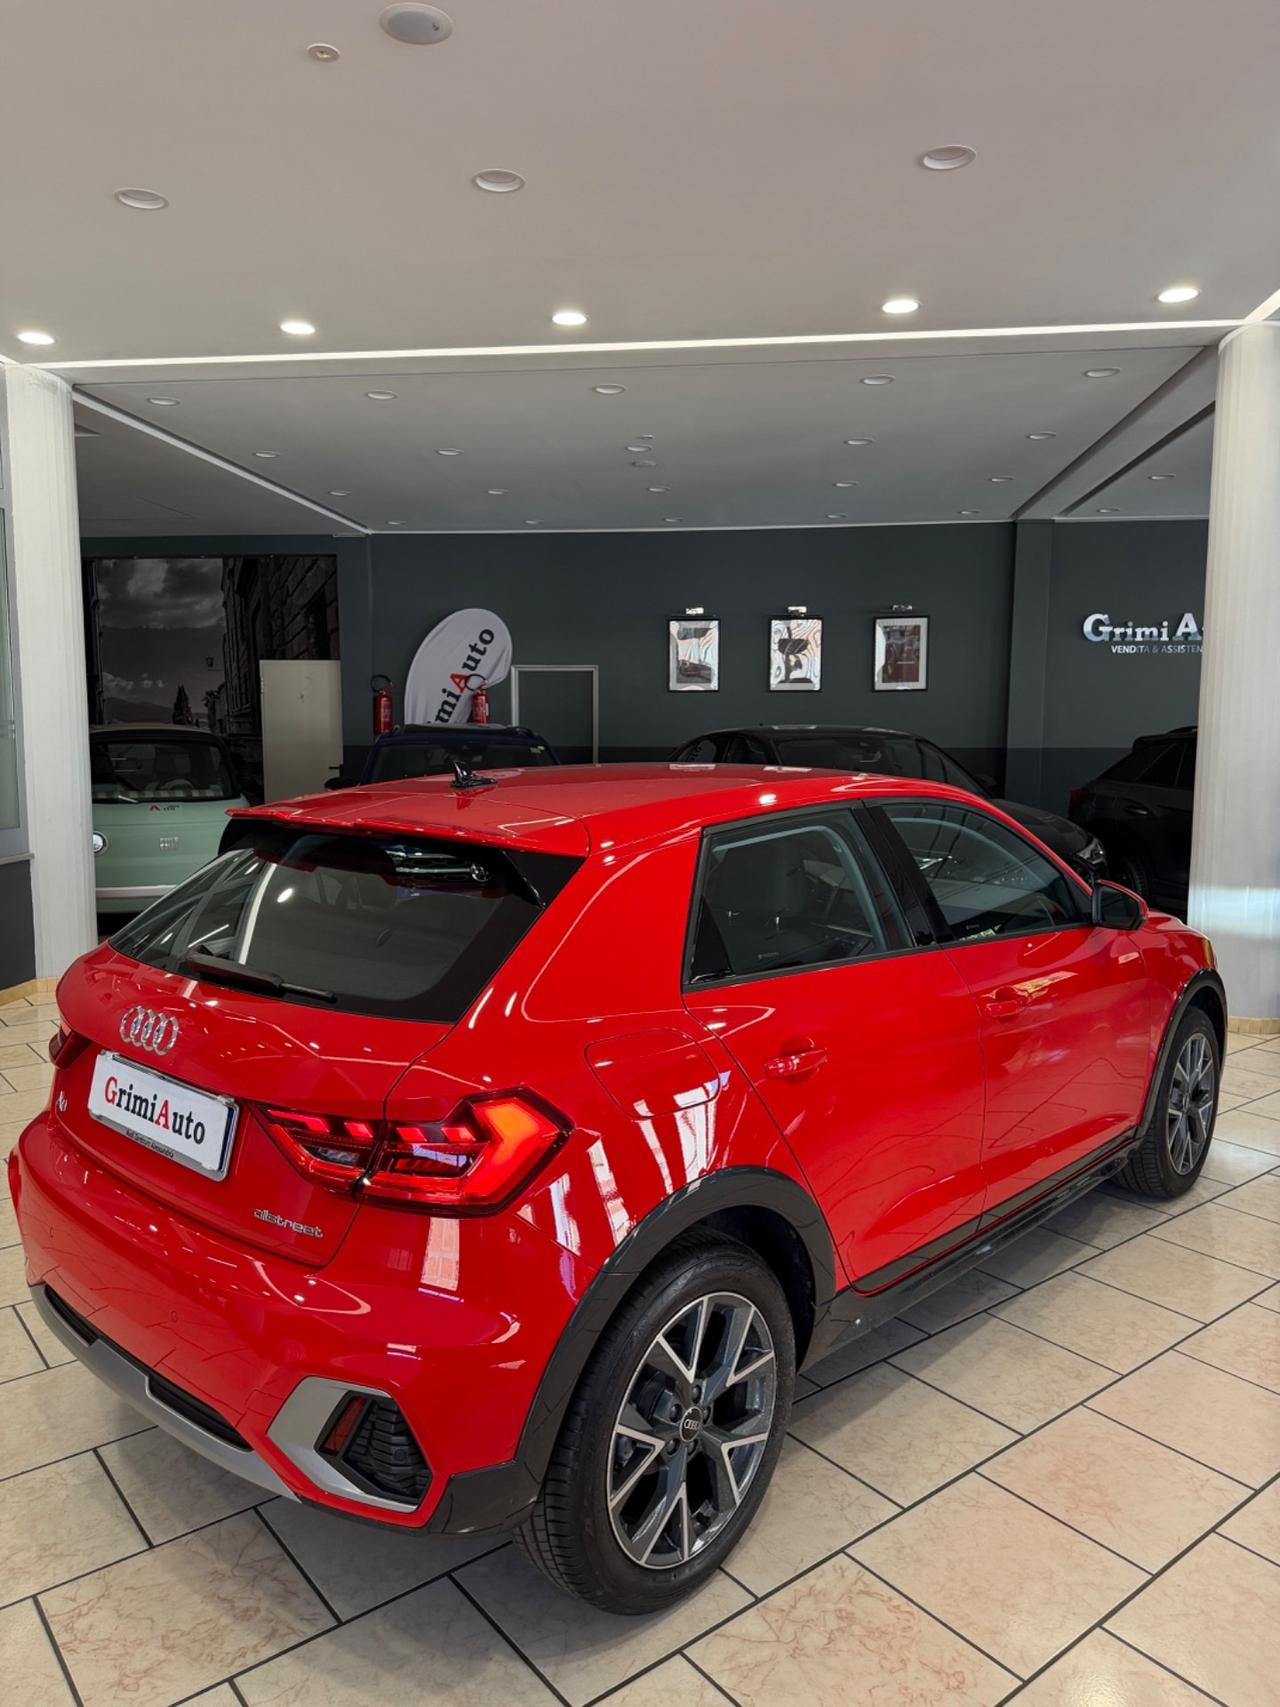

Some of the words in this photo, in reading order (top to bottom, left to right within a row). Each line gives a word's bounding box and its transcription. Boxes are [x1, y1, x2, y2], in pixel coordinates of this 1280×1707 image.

[428, 629, 495, 724] miAuto
[1111, 645, 1150, 654] VENDITA
[1161, 645, 1203, 654] ASSISTEN
[104, 1076, 206, 1145] GrimiAuto
